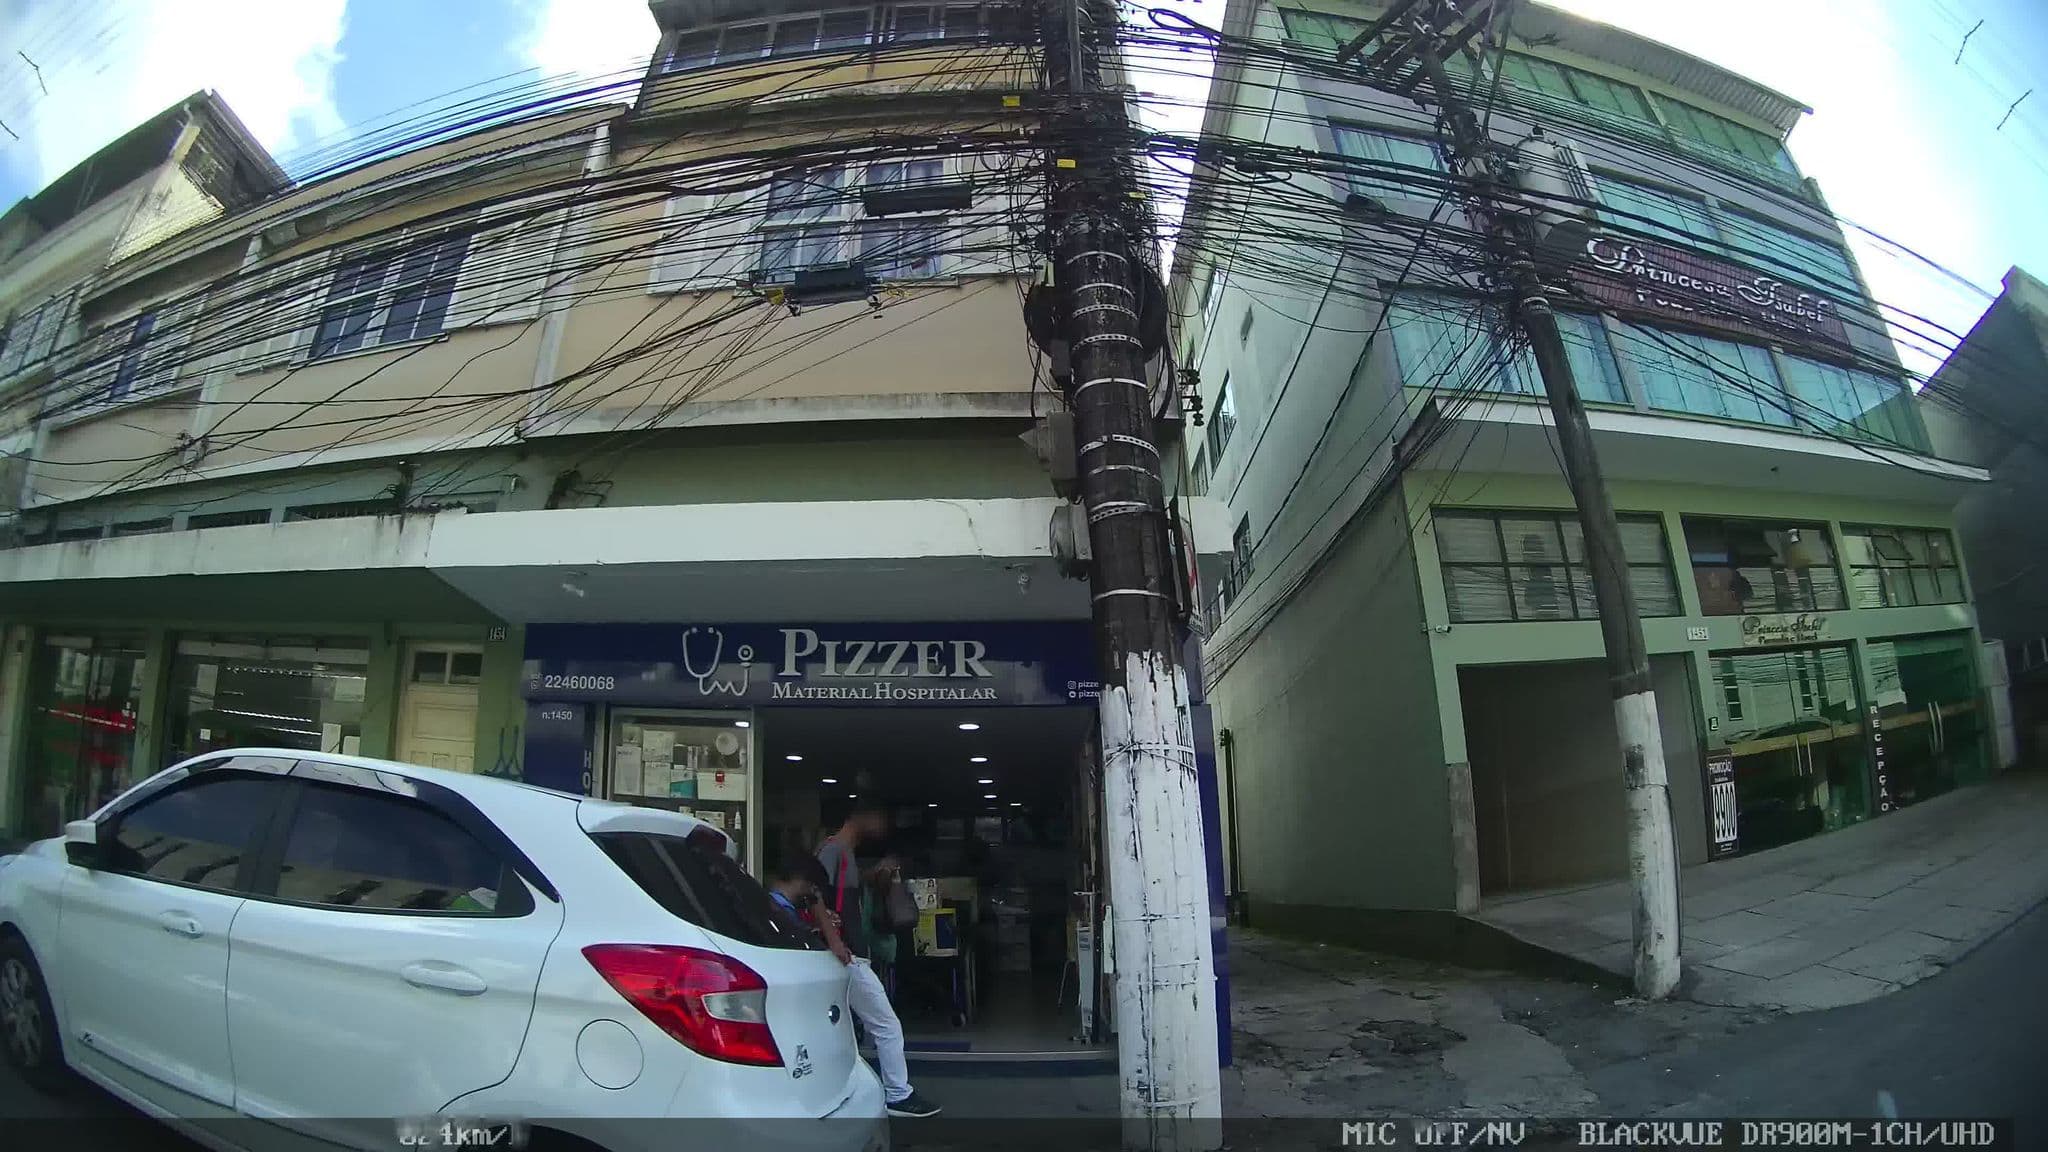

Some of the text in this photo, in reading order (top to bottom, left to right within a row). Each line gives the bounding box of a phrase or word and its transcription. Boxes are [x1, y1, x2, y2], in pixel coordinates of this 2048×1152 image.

[778, 629, 994, 677] PIZZER
[544, 675, 615, 690] 22460068
[772, 682, 997, 700] MATERIAL HOSPITALAR
